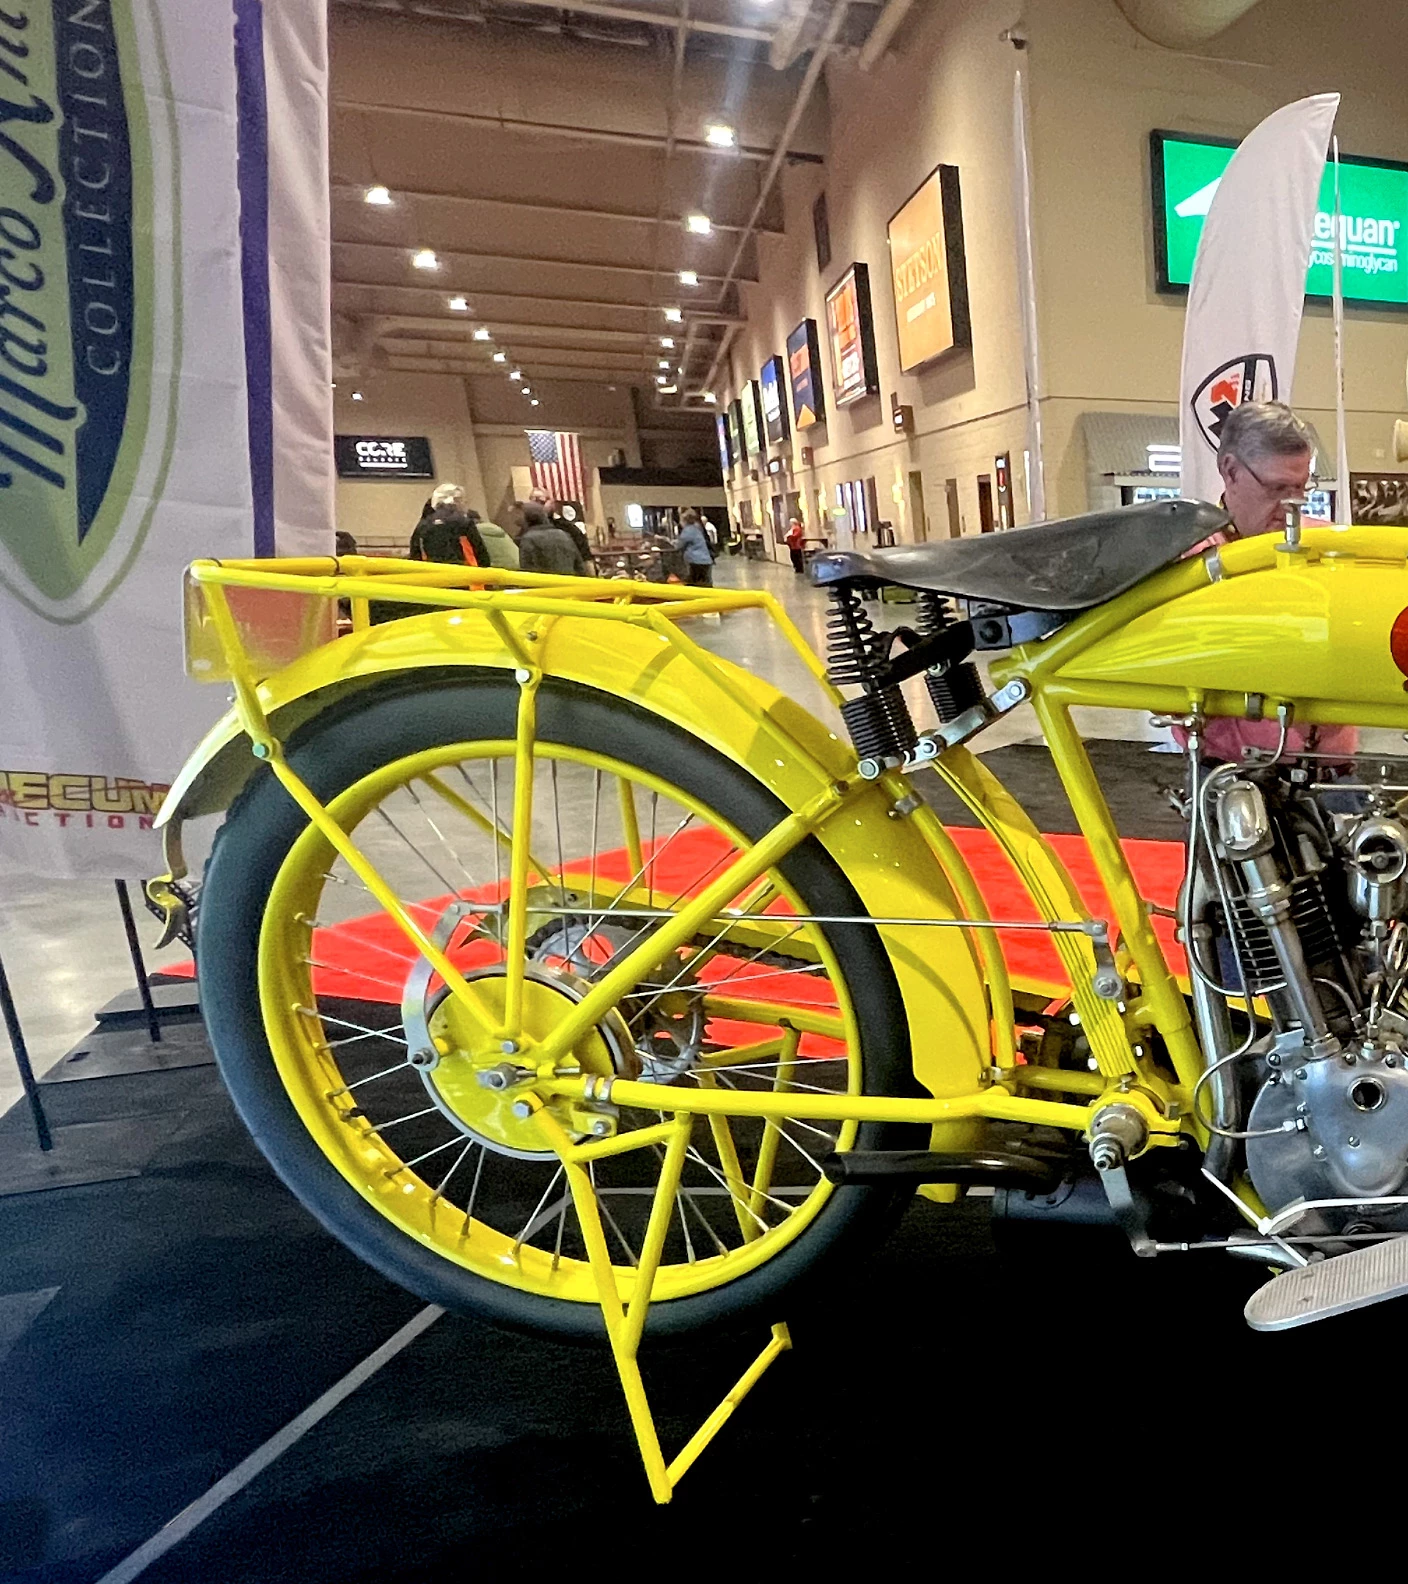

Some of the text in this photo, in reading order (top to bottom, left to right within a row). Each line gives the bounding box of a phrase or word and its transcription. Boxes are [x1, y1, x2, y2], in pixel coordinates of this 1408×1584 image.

[69, 0, 121, 375] COLLECTION
[895, 231, 943, 302] STETSON
[1314, 212, 1395, 250] equan
